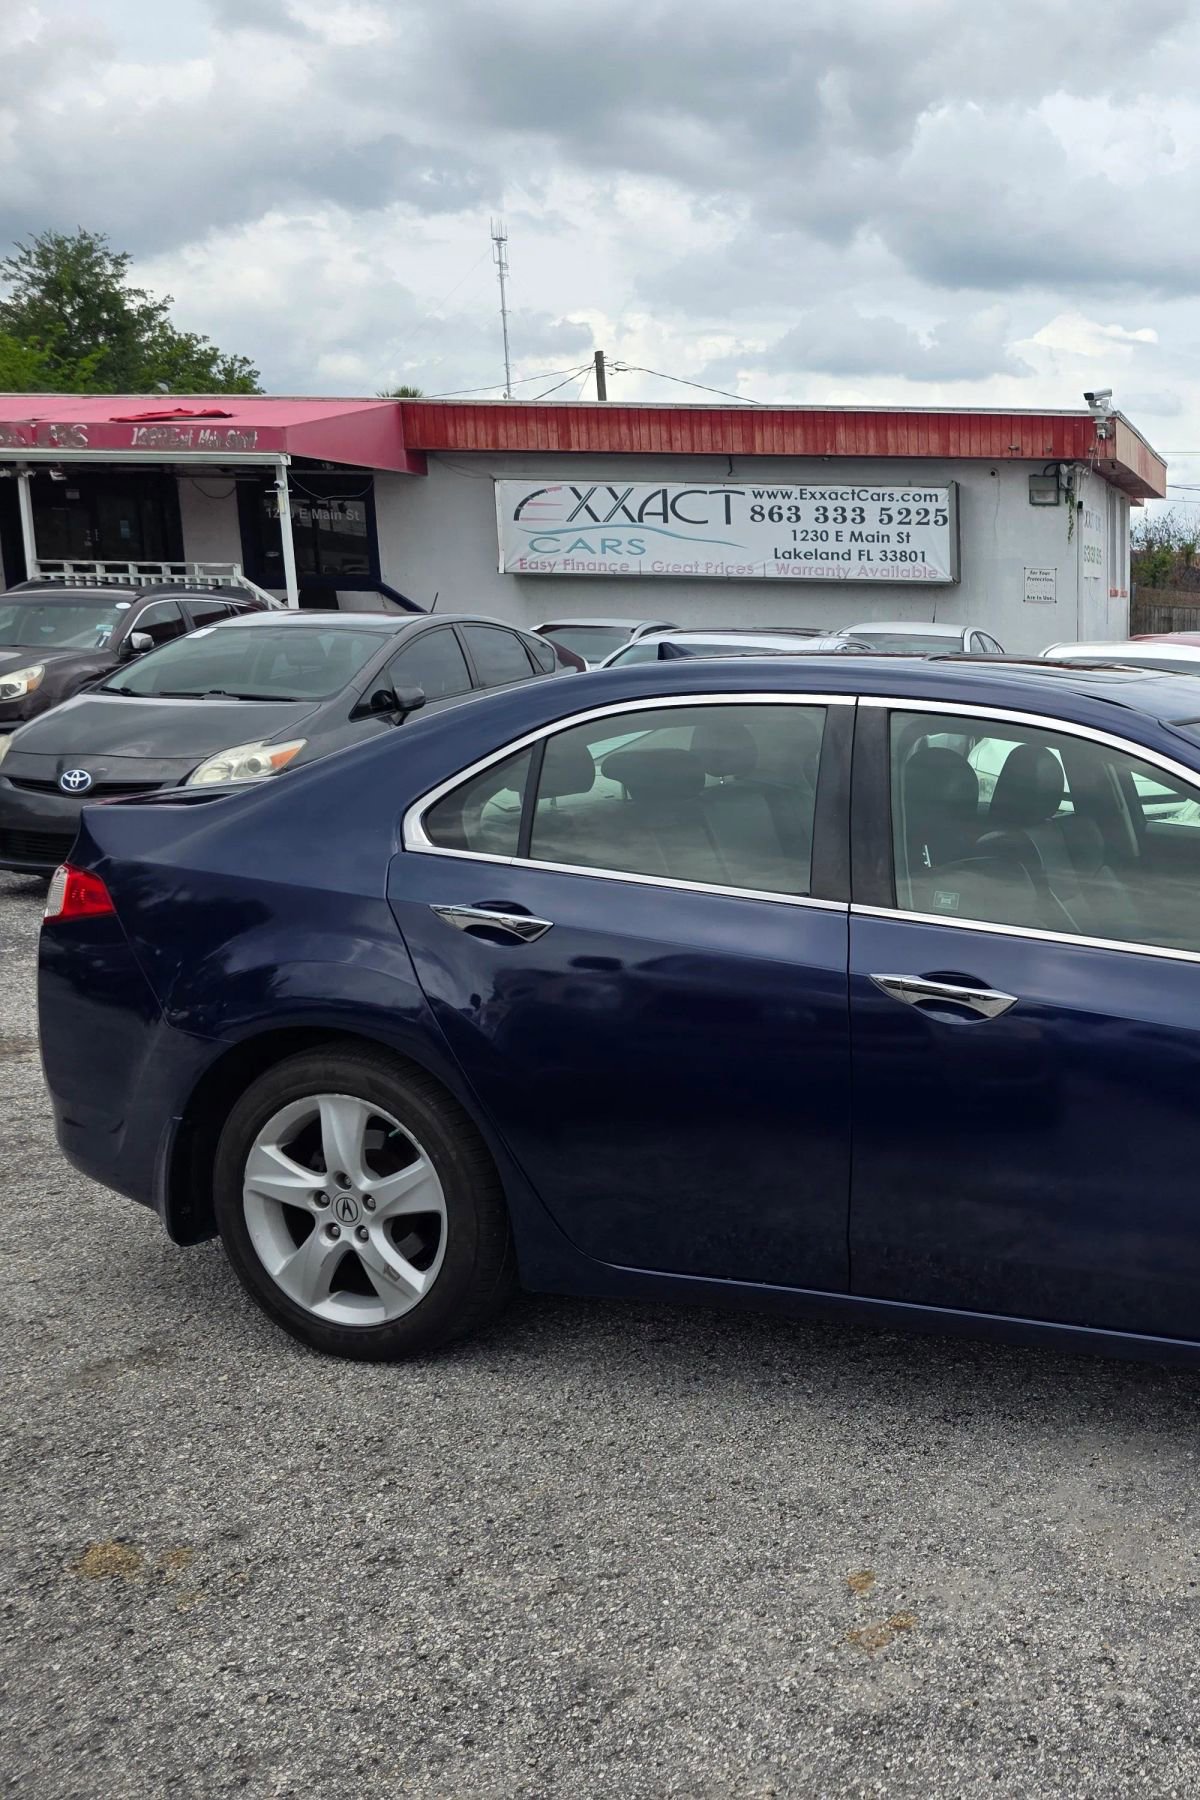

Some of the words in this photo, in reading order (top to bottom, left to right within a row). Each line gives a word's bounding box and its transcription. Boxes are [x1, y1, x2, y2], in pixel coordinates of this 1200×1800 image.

[752, 488, 939, 503] www.ExxactCars.com
[300, 508, 308, 519] E
[312, 508, 341, 520] Main
[346, 509, 360, 520] St
[513, 486, 746, 525] EXXACT
[750, 504, 801, 523] 863
[814, 505, 866, 525] 333
[878, 506, 948, 526] 5225
[791, 529, 829, 542] 1230
[835, 530, 843, 542] E
[850, 530, 890, 544] Main
[896, 531, 911, 544] St
[528, 536, 647, 556] CARS
[774, 547, 851, 561] Lakeland
[858, 549, 874, 562] FL
[879, 550, 926, 563] 33801
[519, 557, 557, 573] Easy
[563, 559, 630, 573] Finance
[651, 560, 700, 574] Great
[706, 561, 754, 576] Prices
[775, 562, 850, 580] Warranty
[857, 564, 938, 579] Available
